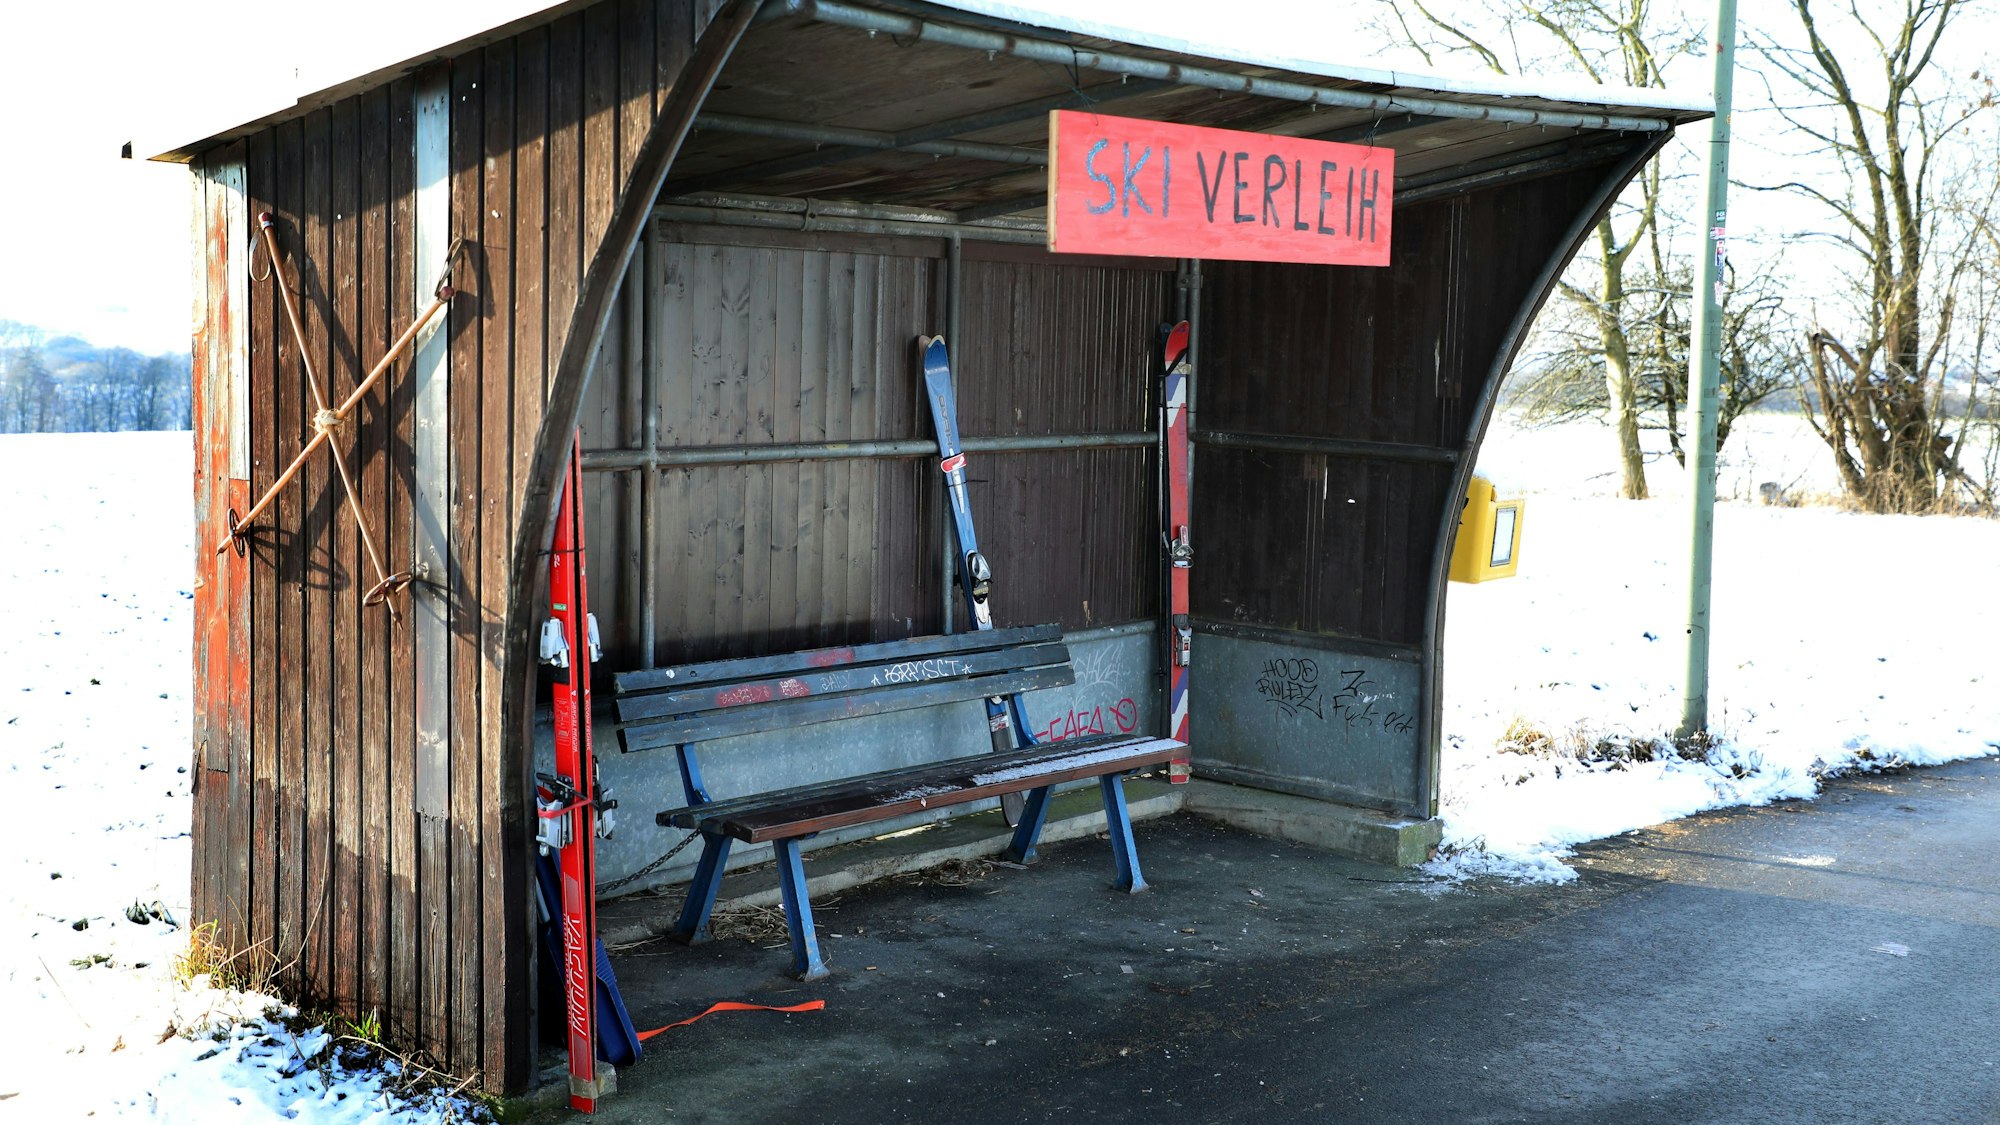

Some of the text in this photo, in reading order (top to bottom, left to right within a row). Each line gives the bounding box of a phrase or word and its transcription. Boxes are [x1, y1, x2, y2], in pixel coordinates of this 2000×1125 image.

[1085, 137, 1379, 243] SKI VERLEIH
[937, 394, 953, 446] HEAD
[1262, 658, 1318, 683] HOOD
[568, 915, 586, 1036] VACUUM
